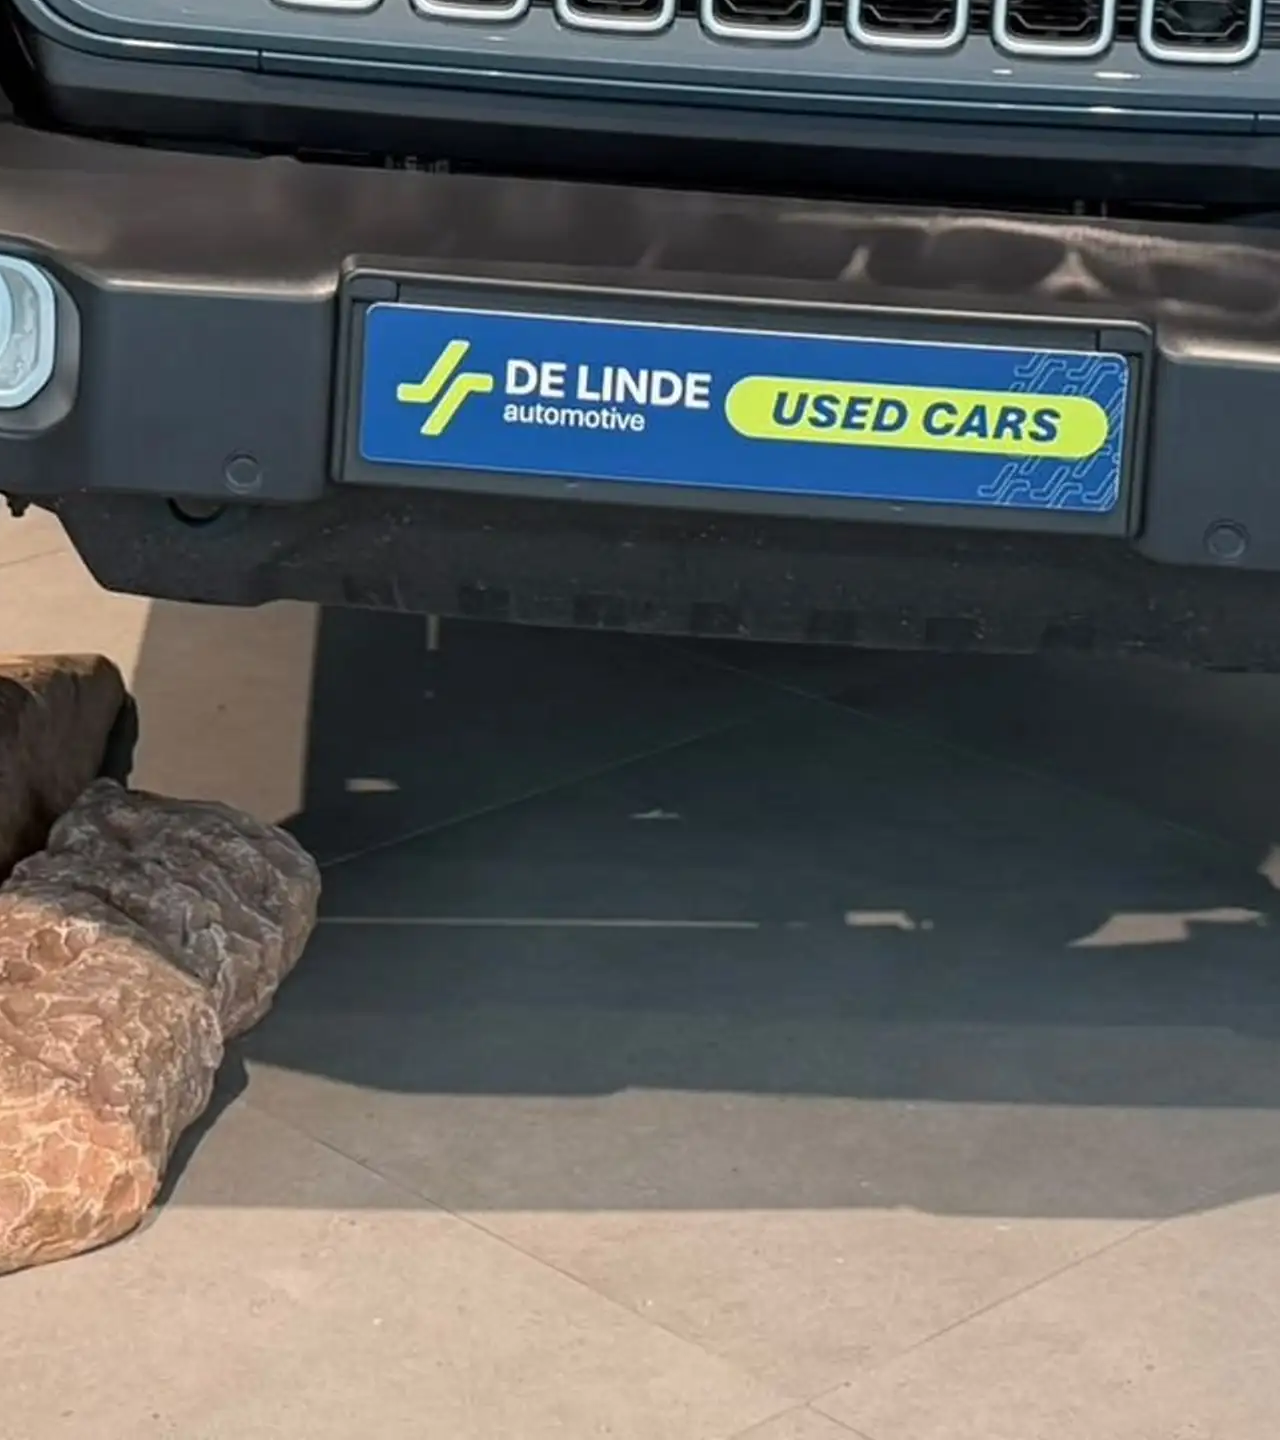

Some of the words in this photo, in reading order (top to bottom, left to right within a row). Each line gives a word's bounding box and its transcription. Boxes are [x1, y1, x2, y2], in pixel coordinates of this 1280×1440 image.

[504, 358, 568, 398] DE
[576, 364, 713, 410] LINDE
[503, 402, 646, 432] automotive
[771, 391, 908, 433] USED
[923, 401, 1061, 442] CARS
